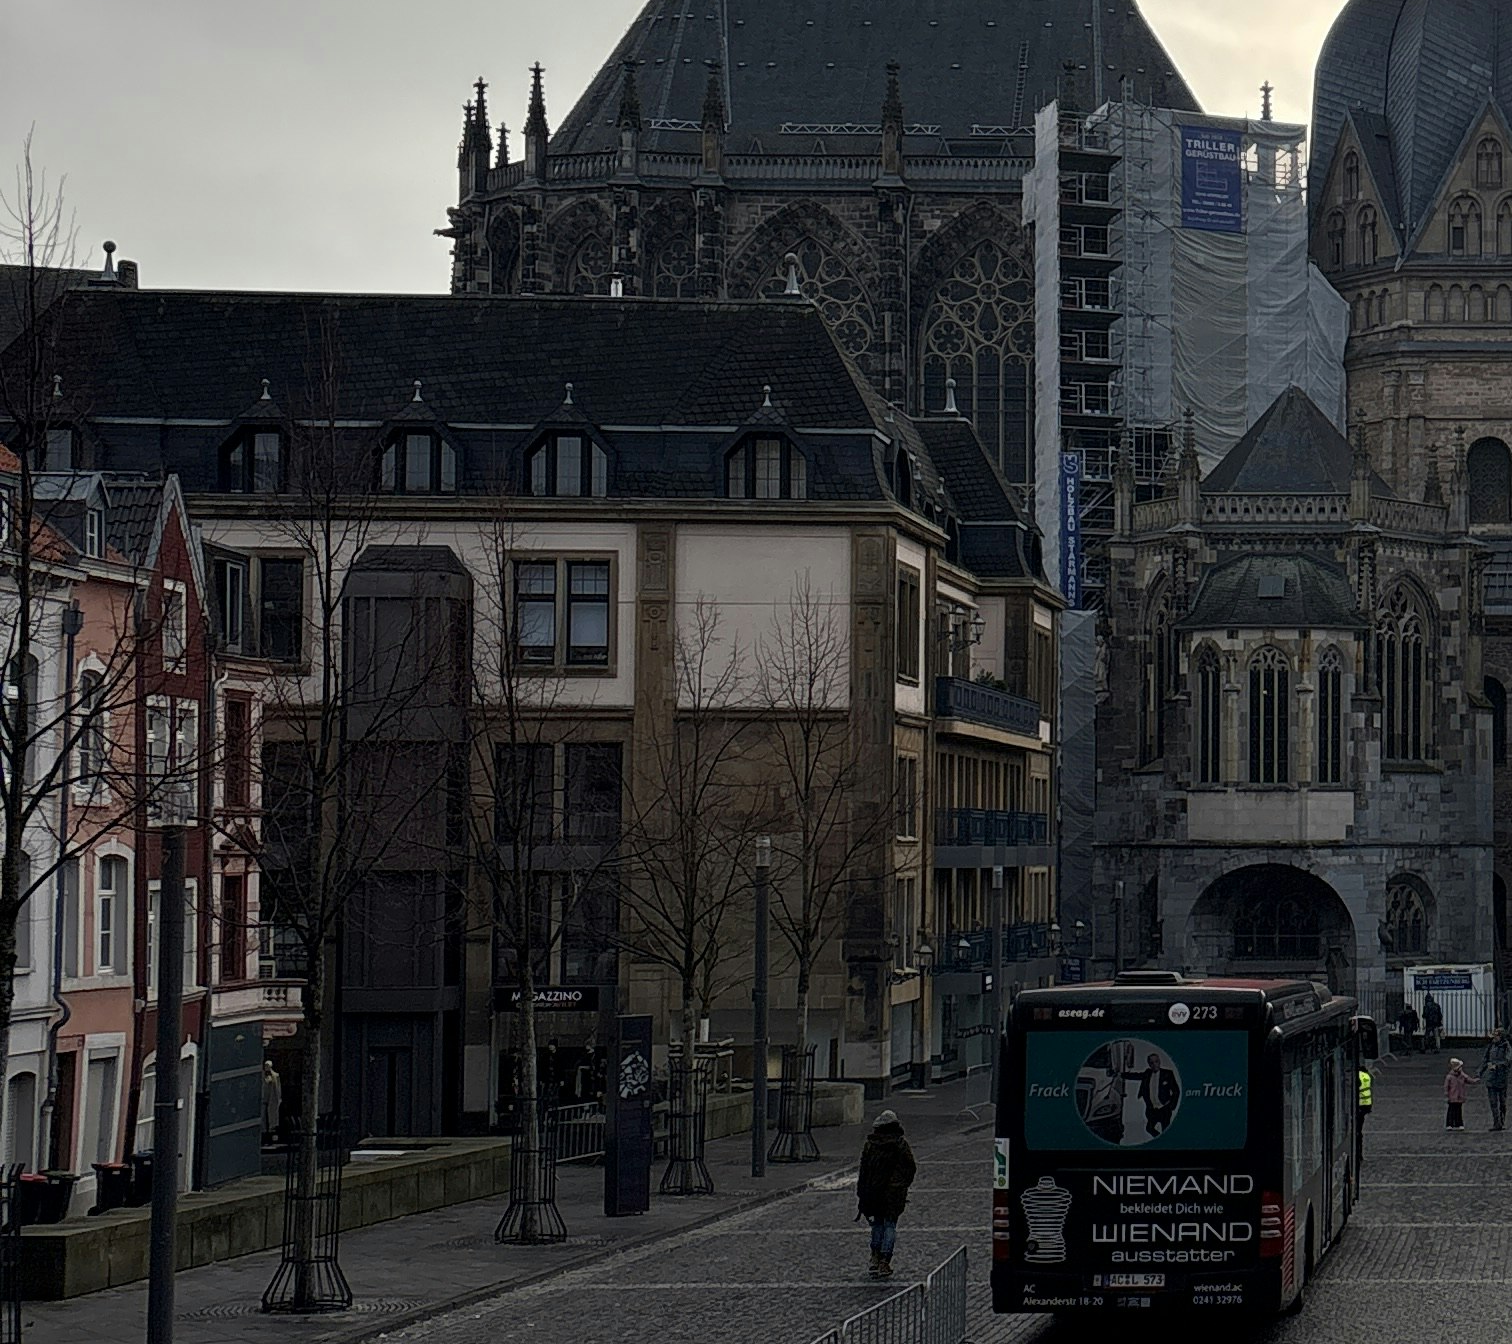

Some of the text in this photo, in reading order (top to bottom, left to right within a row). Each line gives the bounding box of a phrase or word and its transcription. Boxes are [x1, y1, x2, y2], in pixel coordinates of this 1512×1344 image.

[1185, 138, 1235, 153] TRILLER
[1185, 149, 1236, 162] GERÜSTBAU
[1066, 477, 1077, 607] HOLZBAU STARMANNS
[511, 991, 583, 1002] MGAZZINO
[1058, 1007, 1105, 1020] aseag.de
[1192, 1005, 1218, 1020] 273
[1028, 1083, 1069, 1098] Frack
[1202, 1082, 1243, 1097] Truck
[1092, 1174, 1254, 1196] NIEMAND
[1119, 1202, 1224, 1215] bekleidet Dich wie
[1092, 1221, 1253, 1243] WIENAND
[1111, 1248, 1236, 1263] ausstatter
[1143, 1274, 1163, 1285] 573
[1022, 1283, 1036, 1294] AC
[1193, 1282, 1243, 1292] wienand.ac
[1192, 1295, 1243, 1305] 0241 32976
